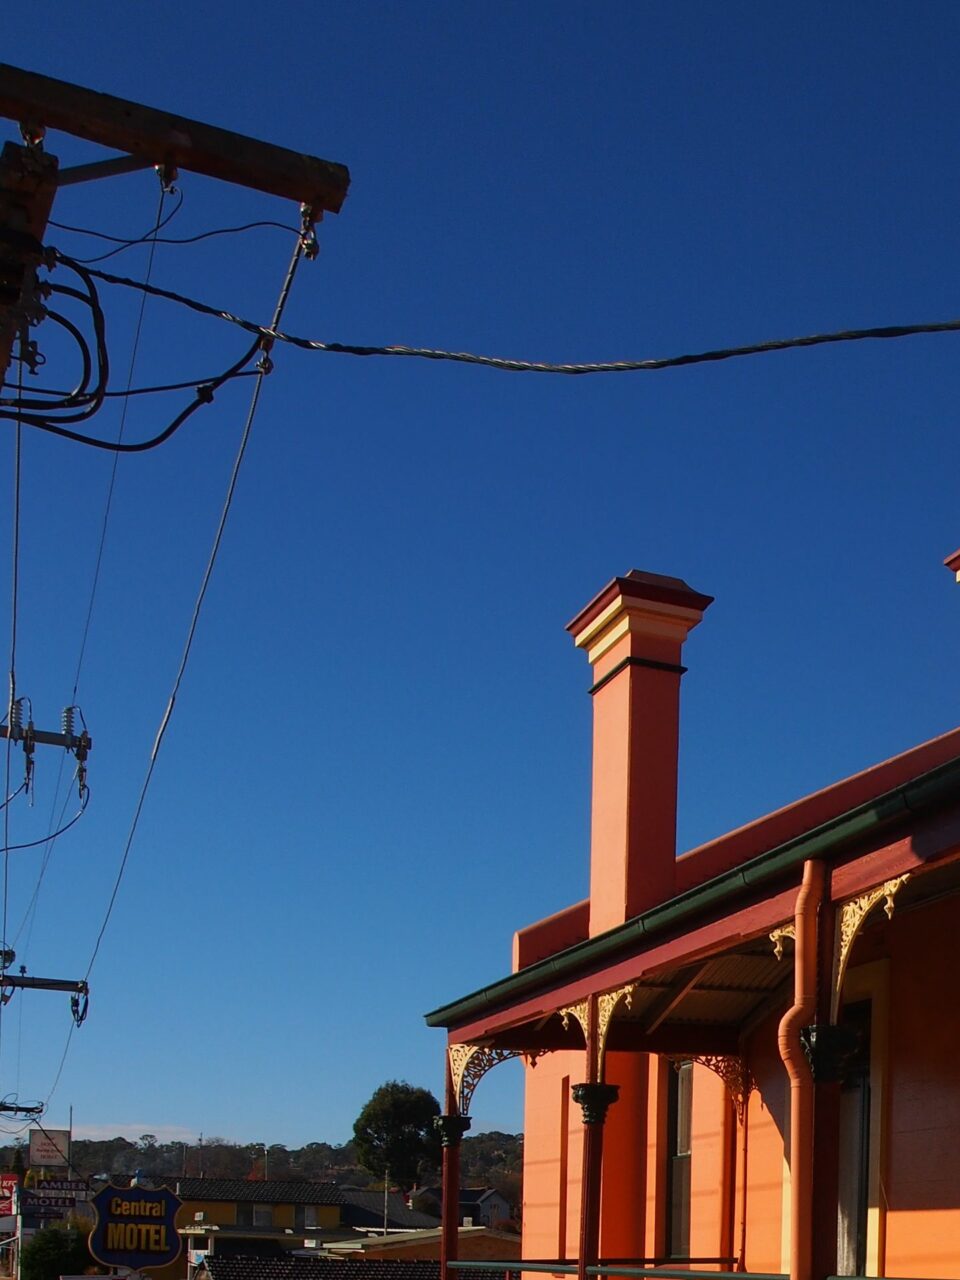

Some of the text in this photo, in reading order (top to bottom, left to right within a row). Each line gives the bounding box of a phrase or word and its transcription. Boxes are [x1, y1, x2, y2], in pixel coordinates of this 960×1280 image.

[39, 1181, 87, 1190] AMBER
[26, 1198, 73, 1207] MOTEL
[111, 1197, 165, 1217] Central
[107, 1223, 170, 1251] MOTEL
